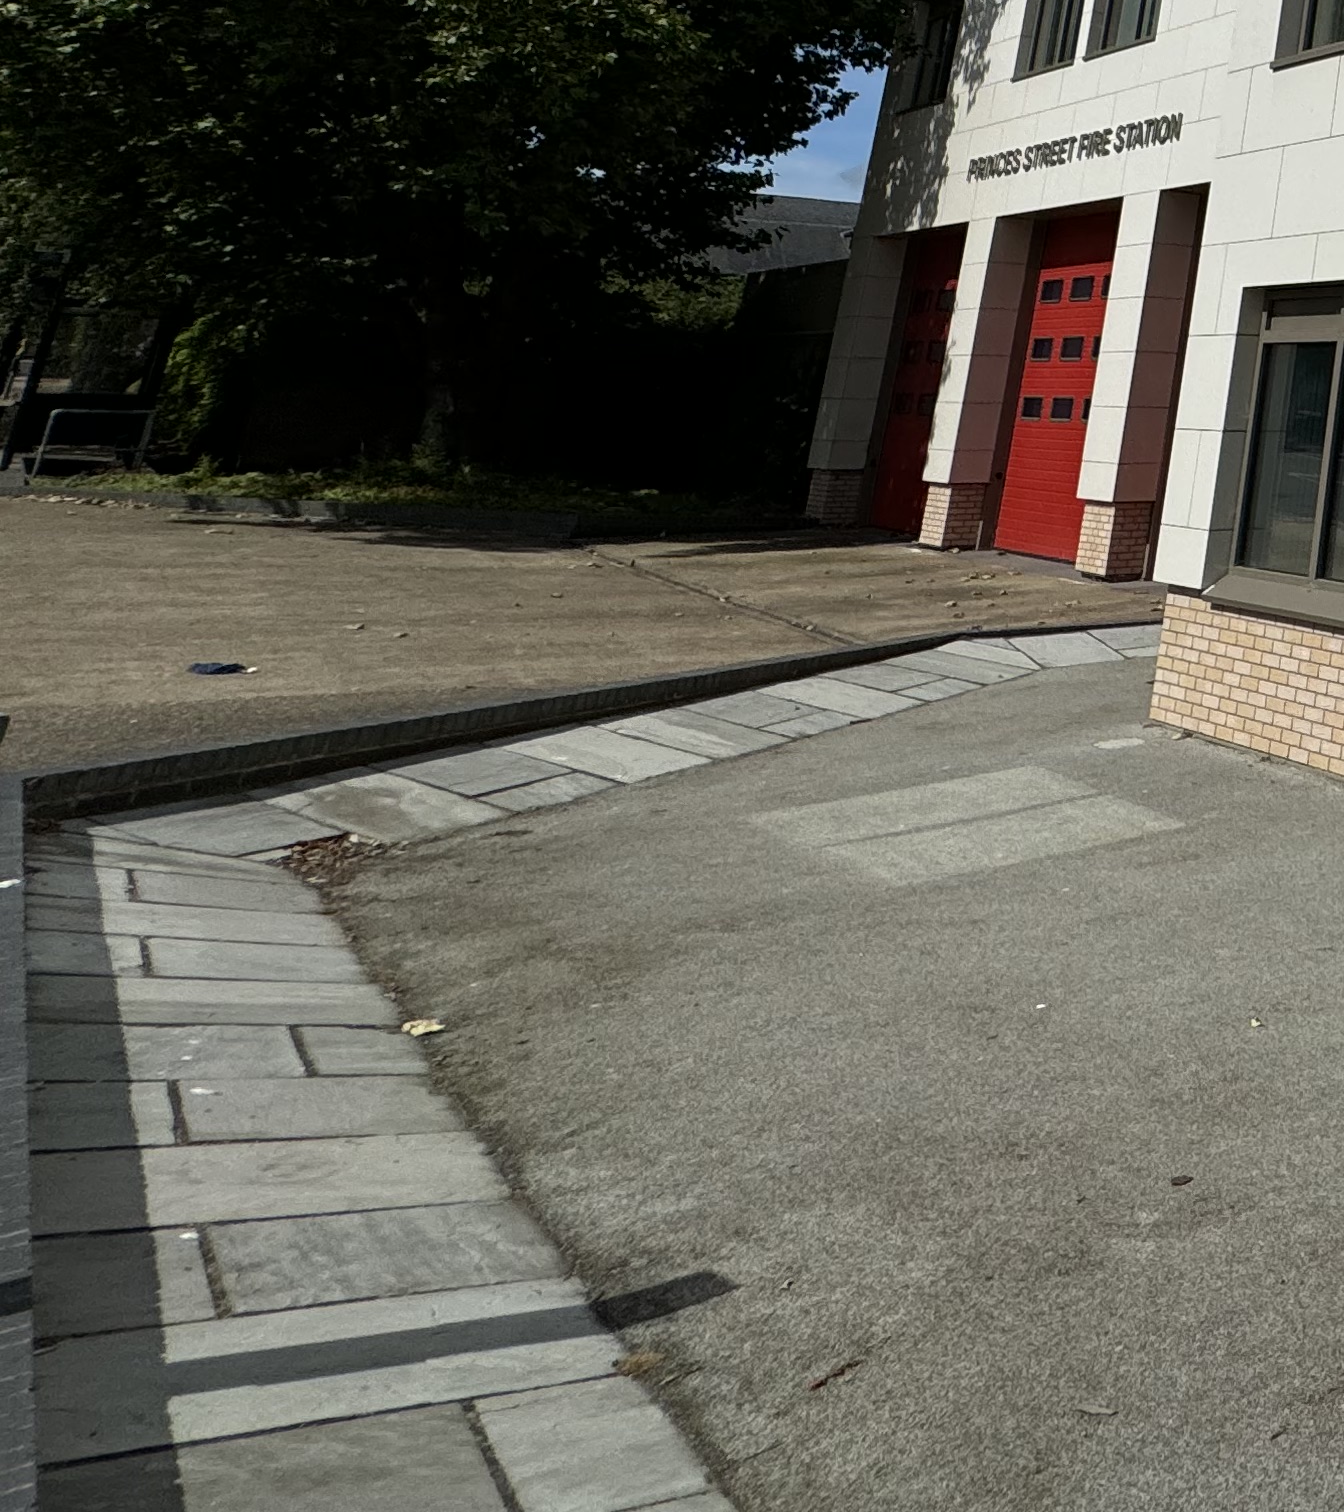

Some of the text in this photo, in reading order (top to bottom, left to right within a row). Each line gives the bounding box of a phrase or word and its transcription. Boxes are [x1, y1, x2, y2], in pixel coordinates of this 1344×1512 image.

[966, 112, 1184, 183] PRINCES STREET FIRE STATION
